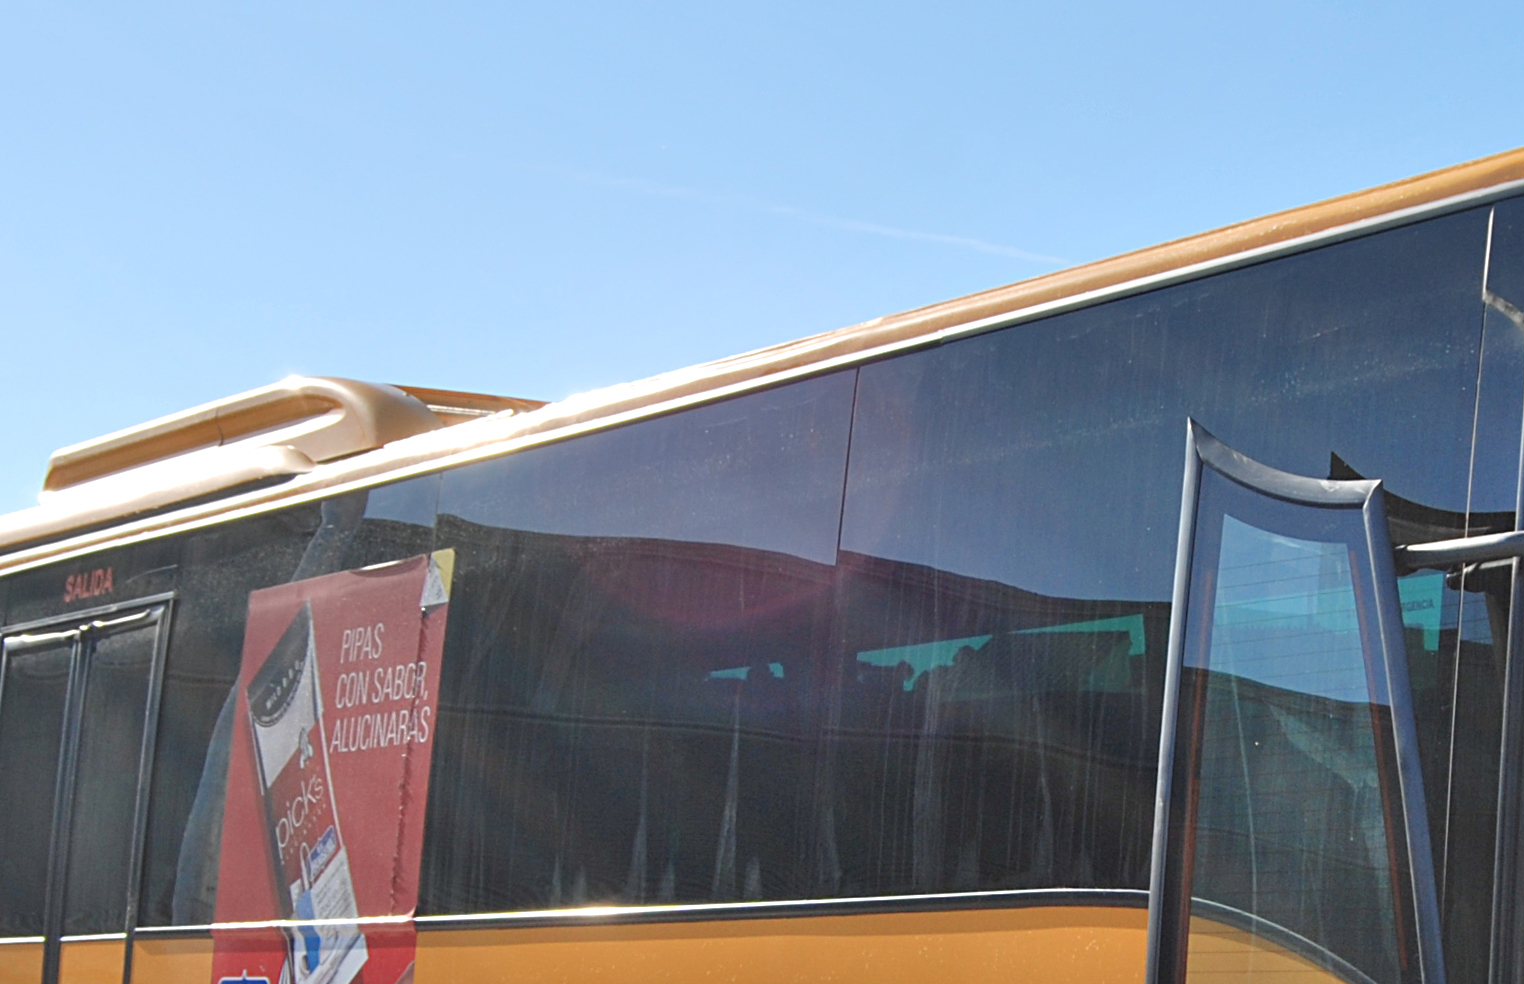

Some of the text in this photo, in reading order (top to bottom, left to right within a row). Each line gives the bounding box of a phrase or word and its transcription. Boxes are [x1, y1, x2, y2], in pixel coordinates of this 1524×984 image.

[63, 566, 114, 602] SALIDA
[340, 622, 385, 664] PIPAS
[335, 670, 370, 708] CON
[371, 661, 429, 704] SABOR,
[329, 699, 431, 754] ALUCINARÁS
